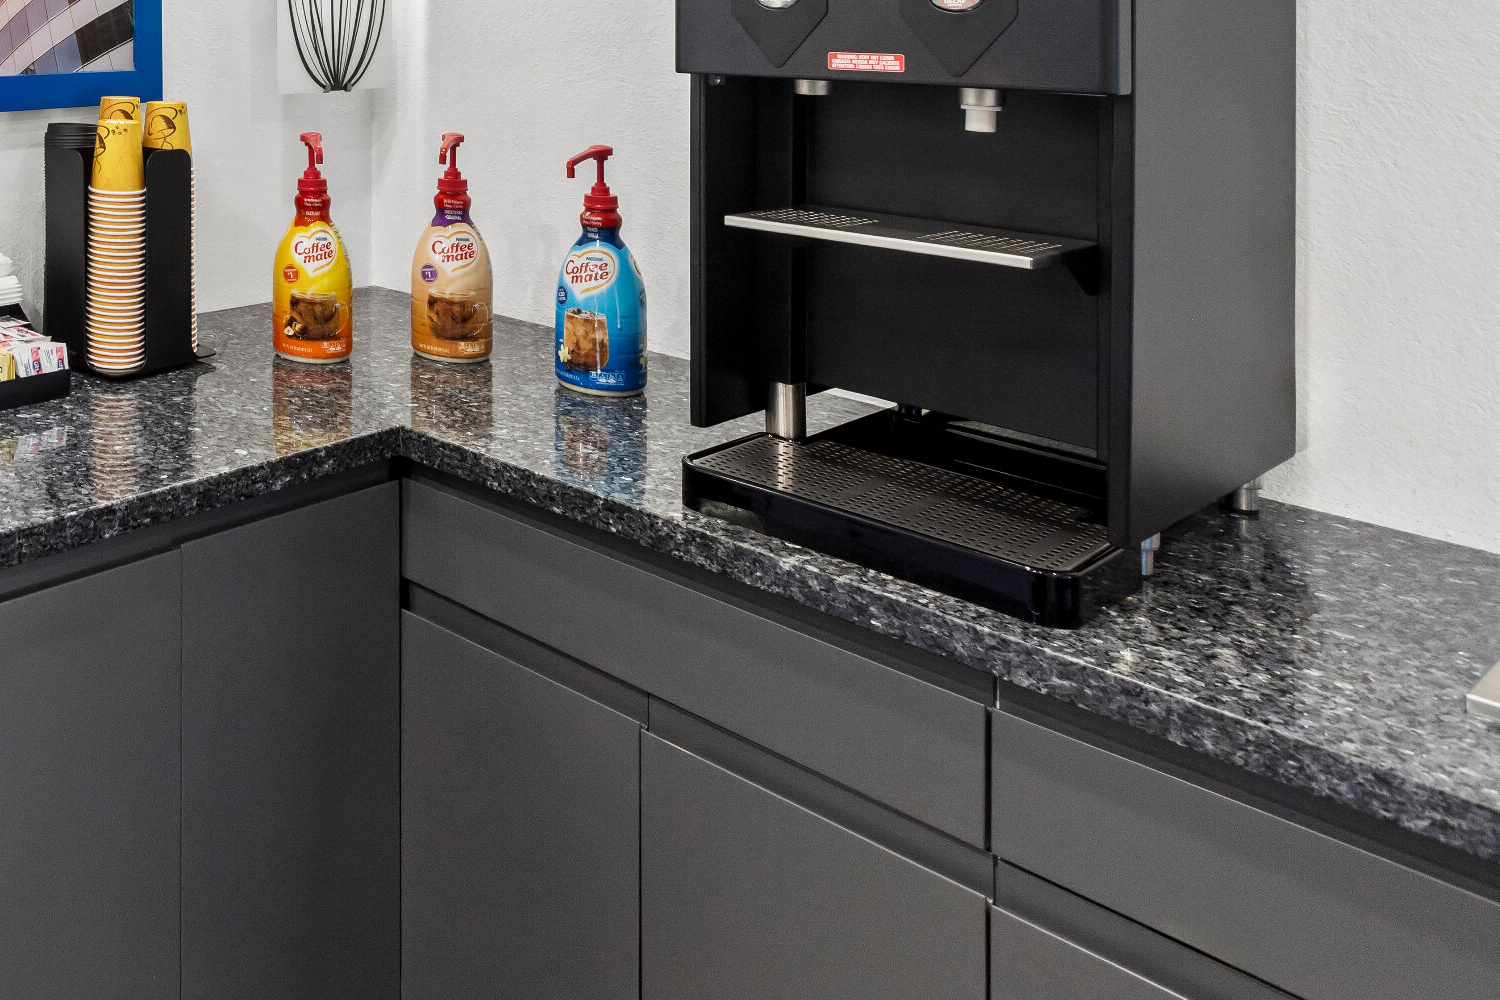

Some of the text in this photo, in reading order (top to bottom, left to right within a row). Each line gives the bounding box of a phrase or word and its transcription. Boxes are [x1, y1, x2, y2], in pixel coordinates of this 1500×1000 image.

[294, 240, 332, 256] Coffee
[431, 240, 474, 255] Coffee
[303, 249, 334, 264] mate
[441, 250, 475, 263] mate
[565, 259, 609, 276] Coffee
[571, 271, 609, 284] mate
